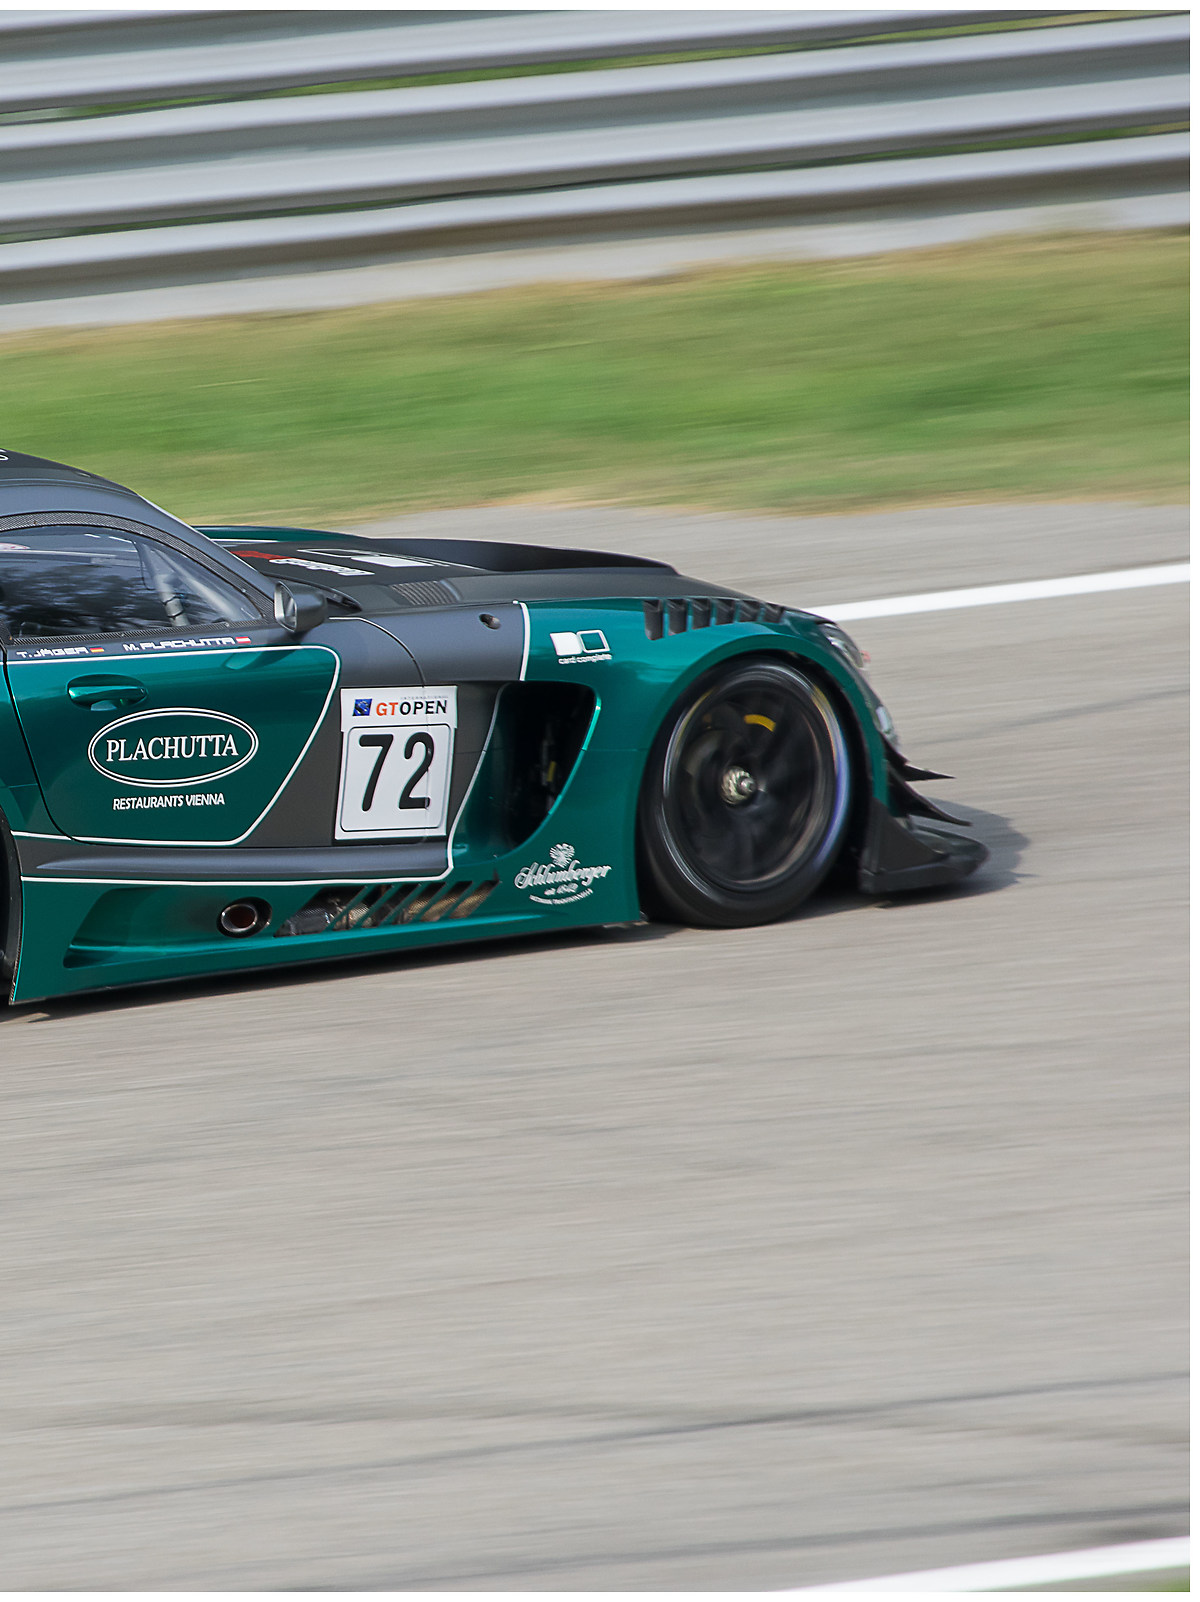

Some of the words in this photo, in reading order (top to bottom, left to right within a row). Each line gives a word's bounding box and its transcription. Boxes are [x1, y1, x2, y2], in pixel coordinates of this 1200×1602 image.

[141, 636, 236, 650] PLACHUTTA
[105, 733, 240, 762] PLACHUTTA
[358, 731, 435, 812] 72
[112, 794, 184, 811] RESTAURANTS
[185, 792, 226, 807] VIENNA
